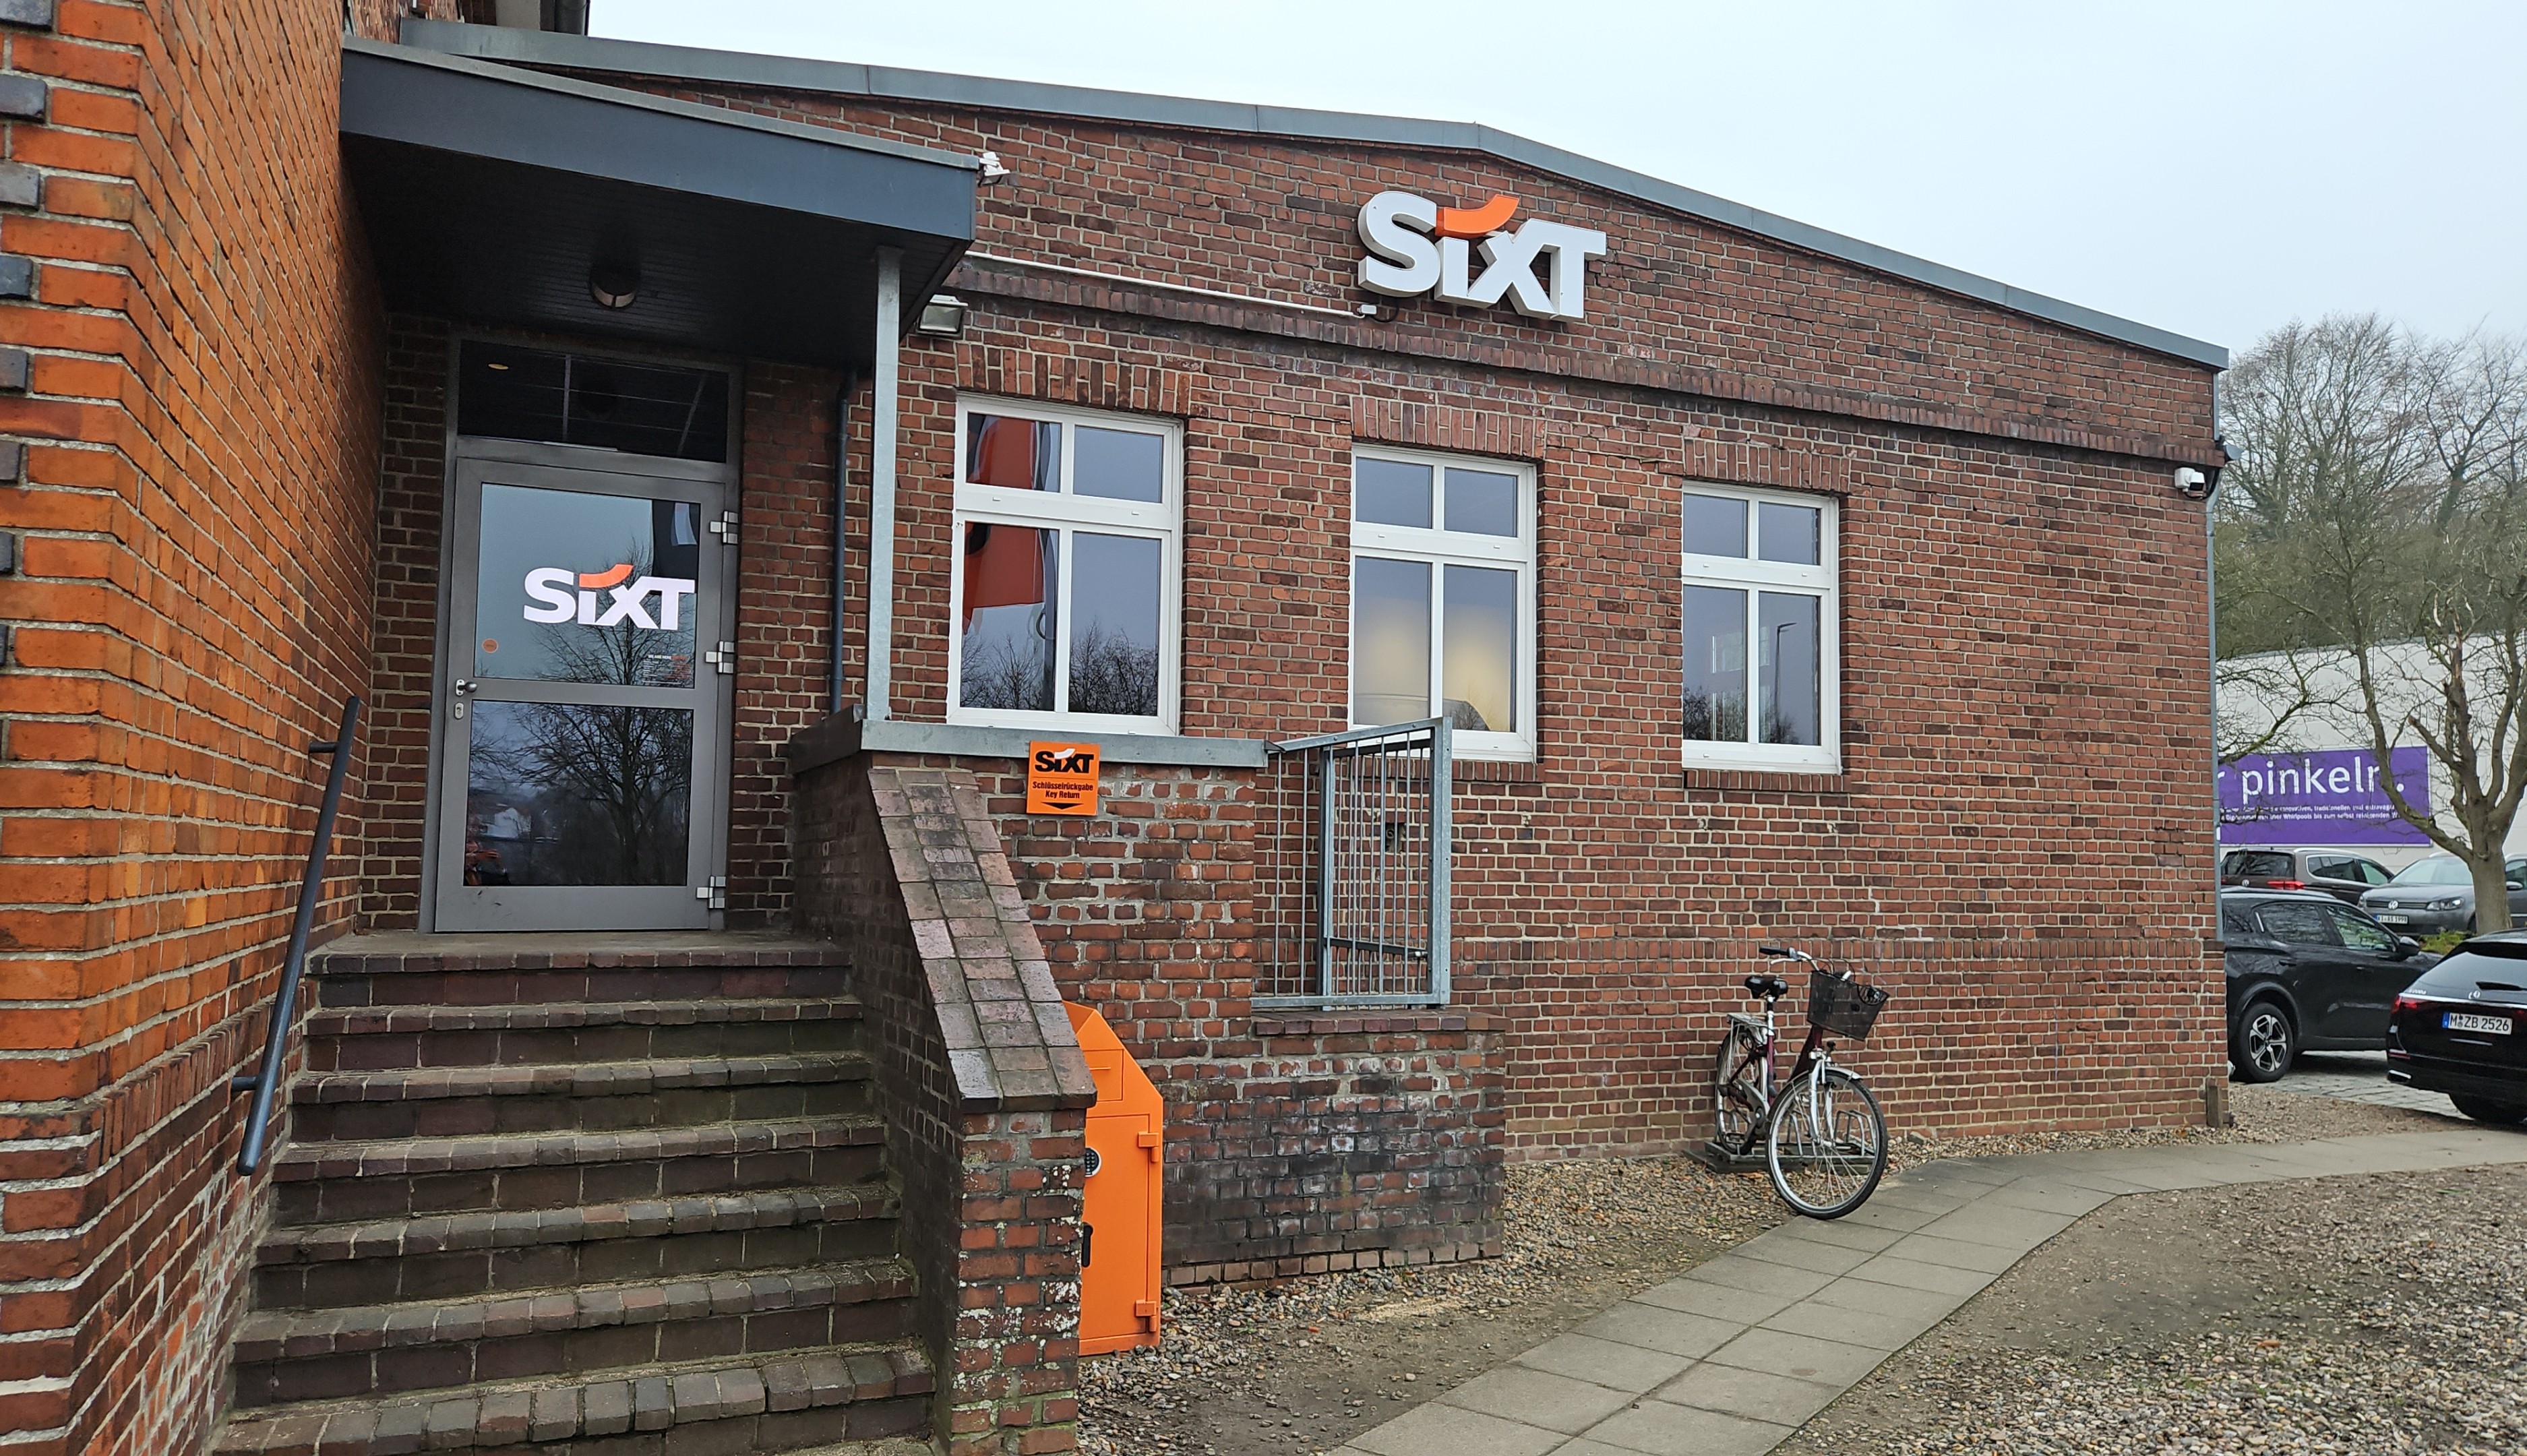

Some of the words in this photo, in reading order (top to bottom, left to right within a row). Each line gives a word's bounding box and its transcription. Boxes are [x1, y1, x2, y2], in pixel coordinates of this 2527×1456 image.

[1033, 781, 1093, 791] Schlüsselrückgabe
[1045, 790, 1058, 799] Key
[1059, 791, 1080, 799] Return
[2283, 812, 2313, 820] Whirlpools
[2450, 1014, 2458, 1027] M
[2464, 1016, 2478, 1029] ZB
[2481, 1018, 2509, 1031] 2526
